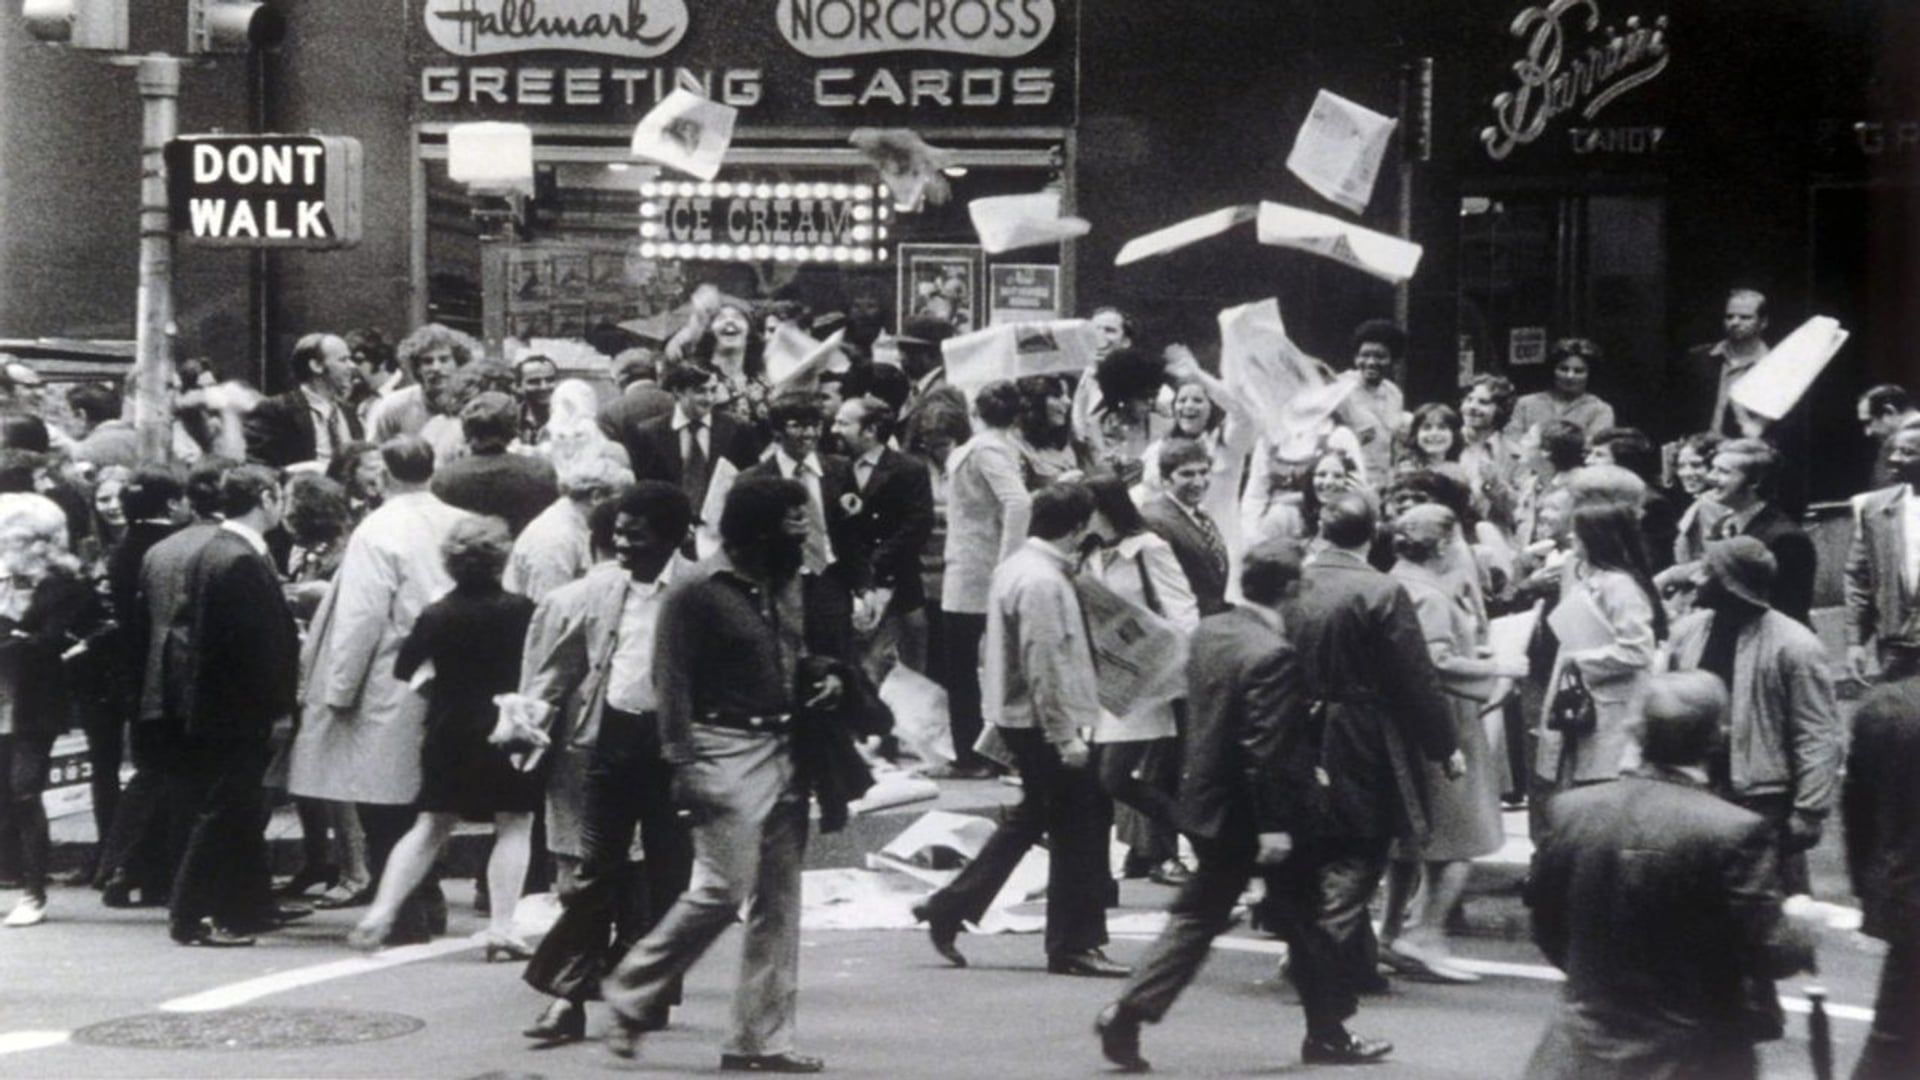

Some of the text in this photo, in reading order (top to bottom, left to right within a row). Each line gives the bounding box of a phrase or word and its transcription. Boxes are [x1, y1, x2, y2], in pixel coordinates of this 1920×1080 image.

[433, 0, 676, 52] Hallmark
[791, 0, 1042, 40] NORCROSS
[421, 67, 1055, 106] GREETING CARDS
[194, 145, 323, 185] DONT
[190, 199, 327, 238] WALK
[657, 199, 852, 244] ICE CREAM
